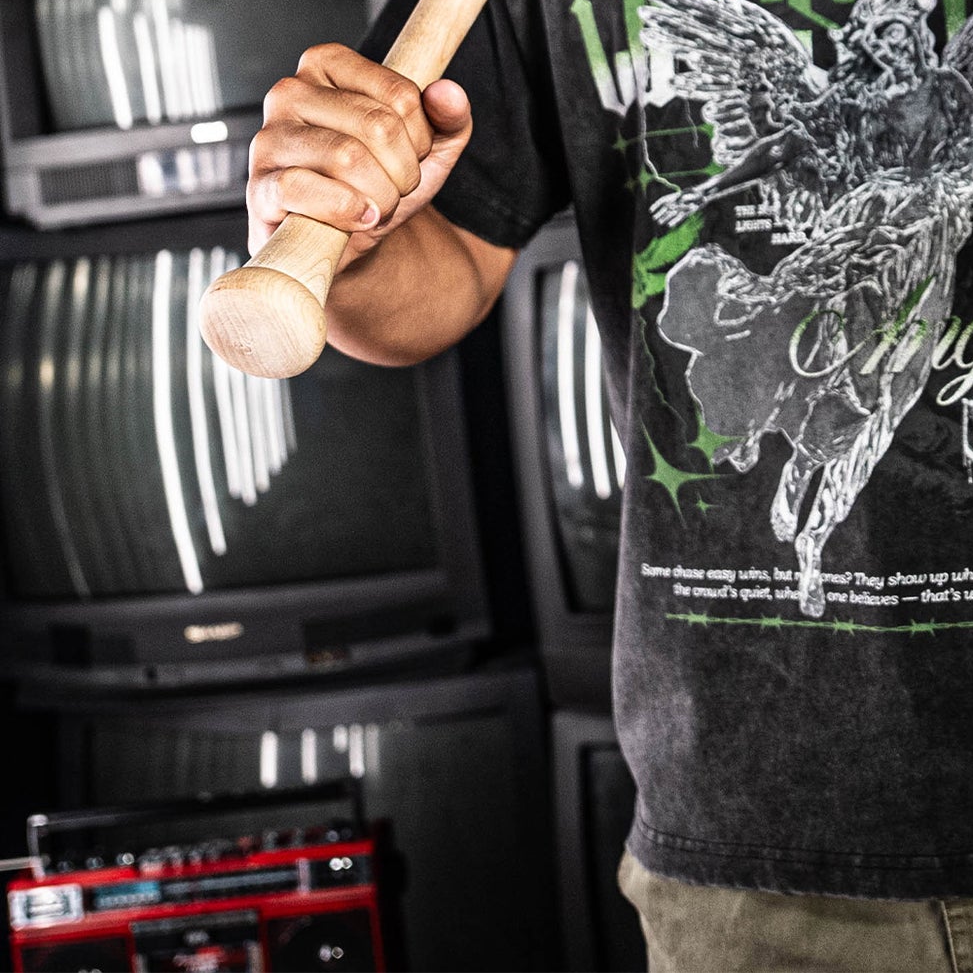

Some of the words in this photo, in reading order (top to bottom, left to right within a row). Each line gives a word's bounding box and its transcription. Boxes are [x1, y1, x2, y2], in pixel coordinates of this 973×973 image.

[640, 563, 671, 578] Some
[672, 565, 705, 580] chase
[706, 568, 736, 583] easy
[854, 572, 885, 590] They
[888, 572, 927, 587] show
[929, 573, 949, 586] up
[673, 582, 691, 597] the
[826, 591, 848, 603] one
[849, 590, 899, 606] believes
[920, 588, 961, 604] that's
